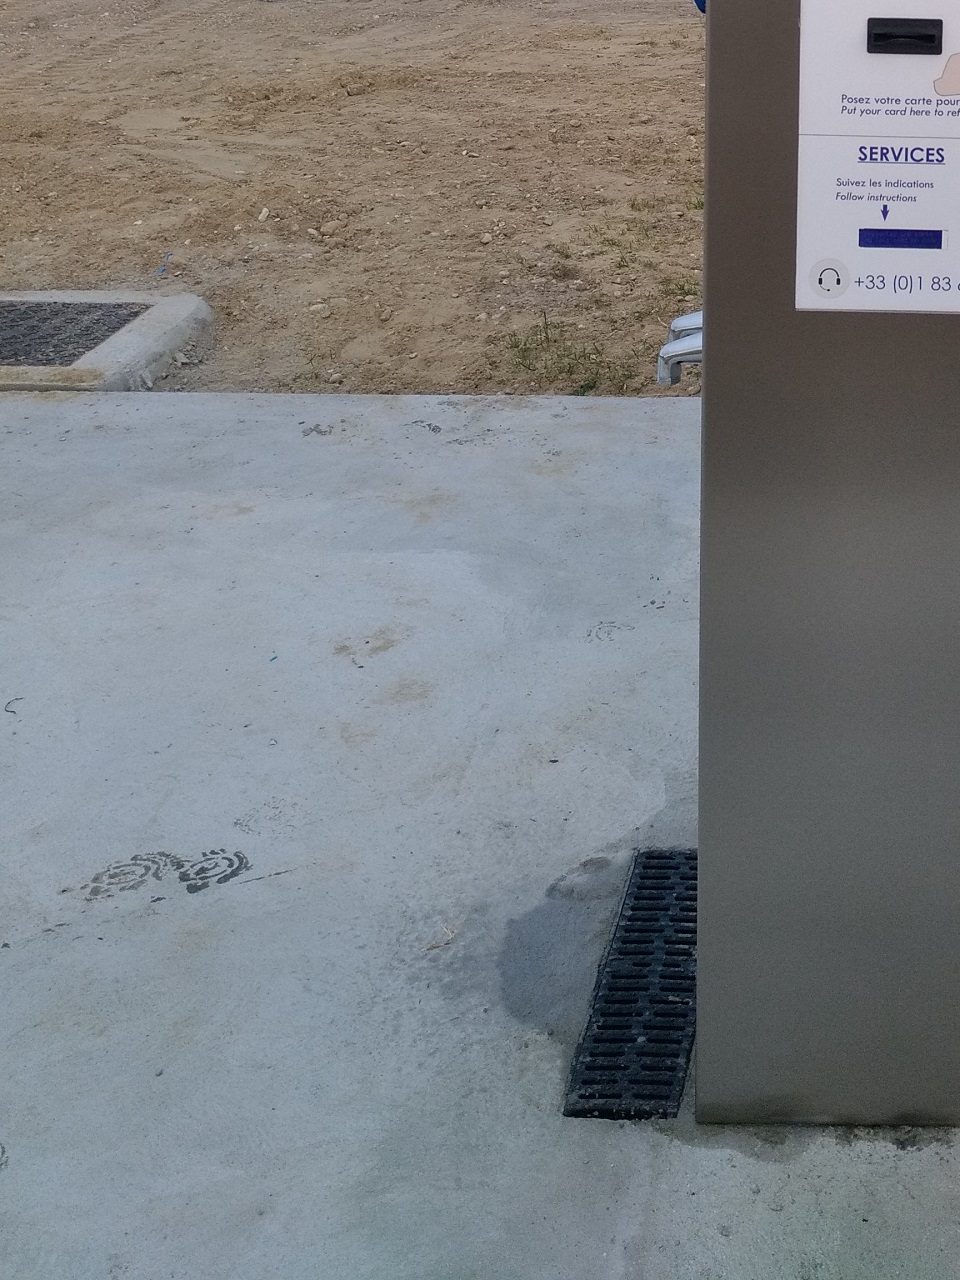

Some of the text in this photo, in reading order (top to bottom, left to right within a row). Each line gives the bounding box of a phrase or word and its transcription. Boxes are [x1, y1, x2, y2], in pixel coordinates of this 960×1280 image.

[840, 94, 871, 105] Posez
[874, 97, 901, 106] votre
[904, 97, 932, 106] carte
[935, 98, 960, 108] pour
[840, 105, 857, 115] Put
[859, 107, 882, 117] your
[884, 106, 907, 116] card
[909, 107, 931, 117] here
[934, 108, 944, 117] to
[857, 145, 945, 163] SERVICES
[835, 177, 935, 189] Suivez les indications
[835, 191, 917, 203] Follow instructions
[854, 274, 886, 290] +33
[930, 275, 952, 292] 83
